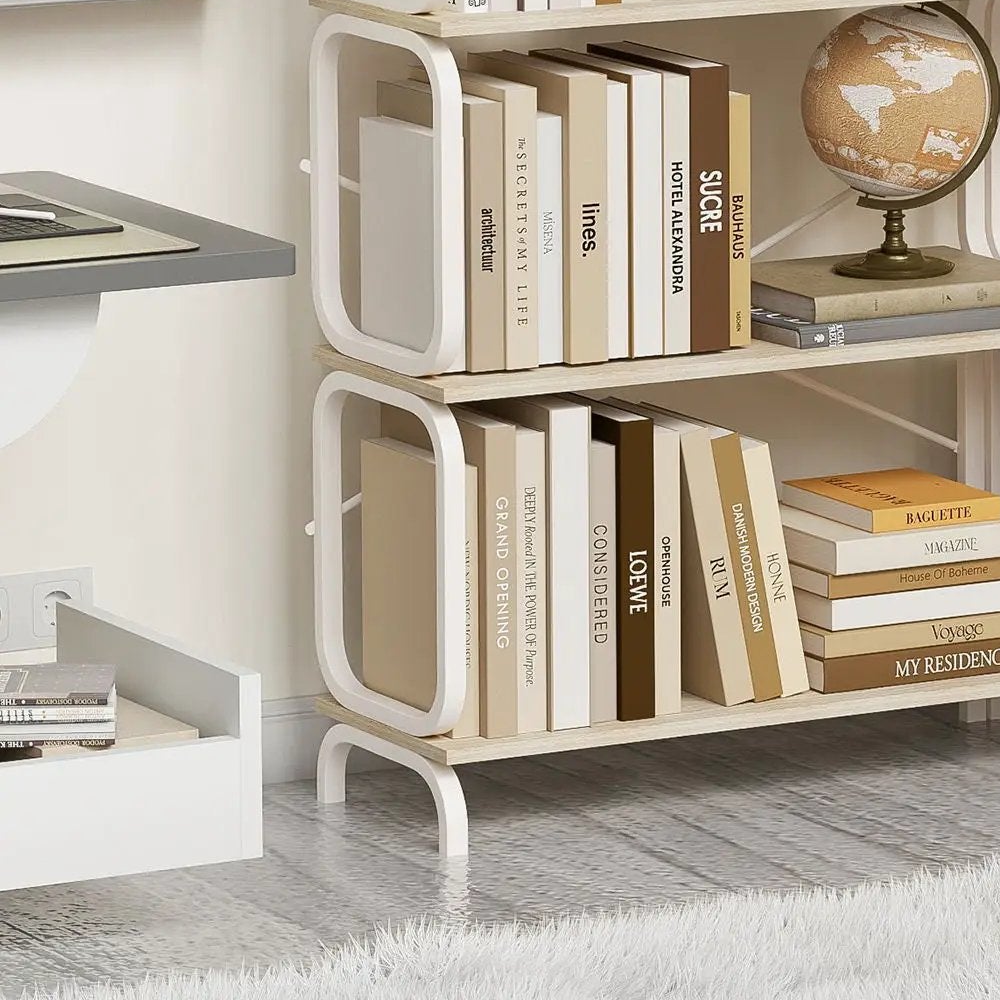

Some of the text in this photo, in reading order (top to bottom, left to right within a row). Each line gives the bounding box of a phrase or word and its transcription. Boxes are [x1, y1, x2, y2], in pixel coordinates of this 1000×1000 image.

[516, 153, 527, 234] SECRETS
[700, 170, 722, 234] SUCRE
[482, 208, 496, 273] architectuur
[582, 203, 600, 258] lines.
[672, 162, 684, 295] HOTEL ALEXANDRA
[732, 195, 744, 260] BAUHAUS
[906, 506, 972, 525] BAGUETTE
[924, 538, 978, 556] MAGAZINE
[496, 496, 510, 650] GRAND OPENING
[593, 523, 608, 644] CONSIDERED
[630, 550, 648, 616] LOEWE
[662, 536, 671, 608] OPENHOUSE
[710, 556, 732, 600] RUM
[766, 552, 787, 604] HONNE
[900, 564, 989, 584] House Boheme
[931, 622, 984, 643] Voyage
[895, 660, 922, 678] MY
